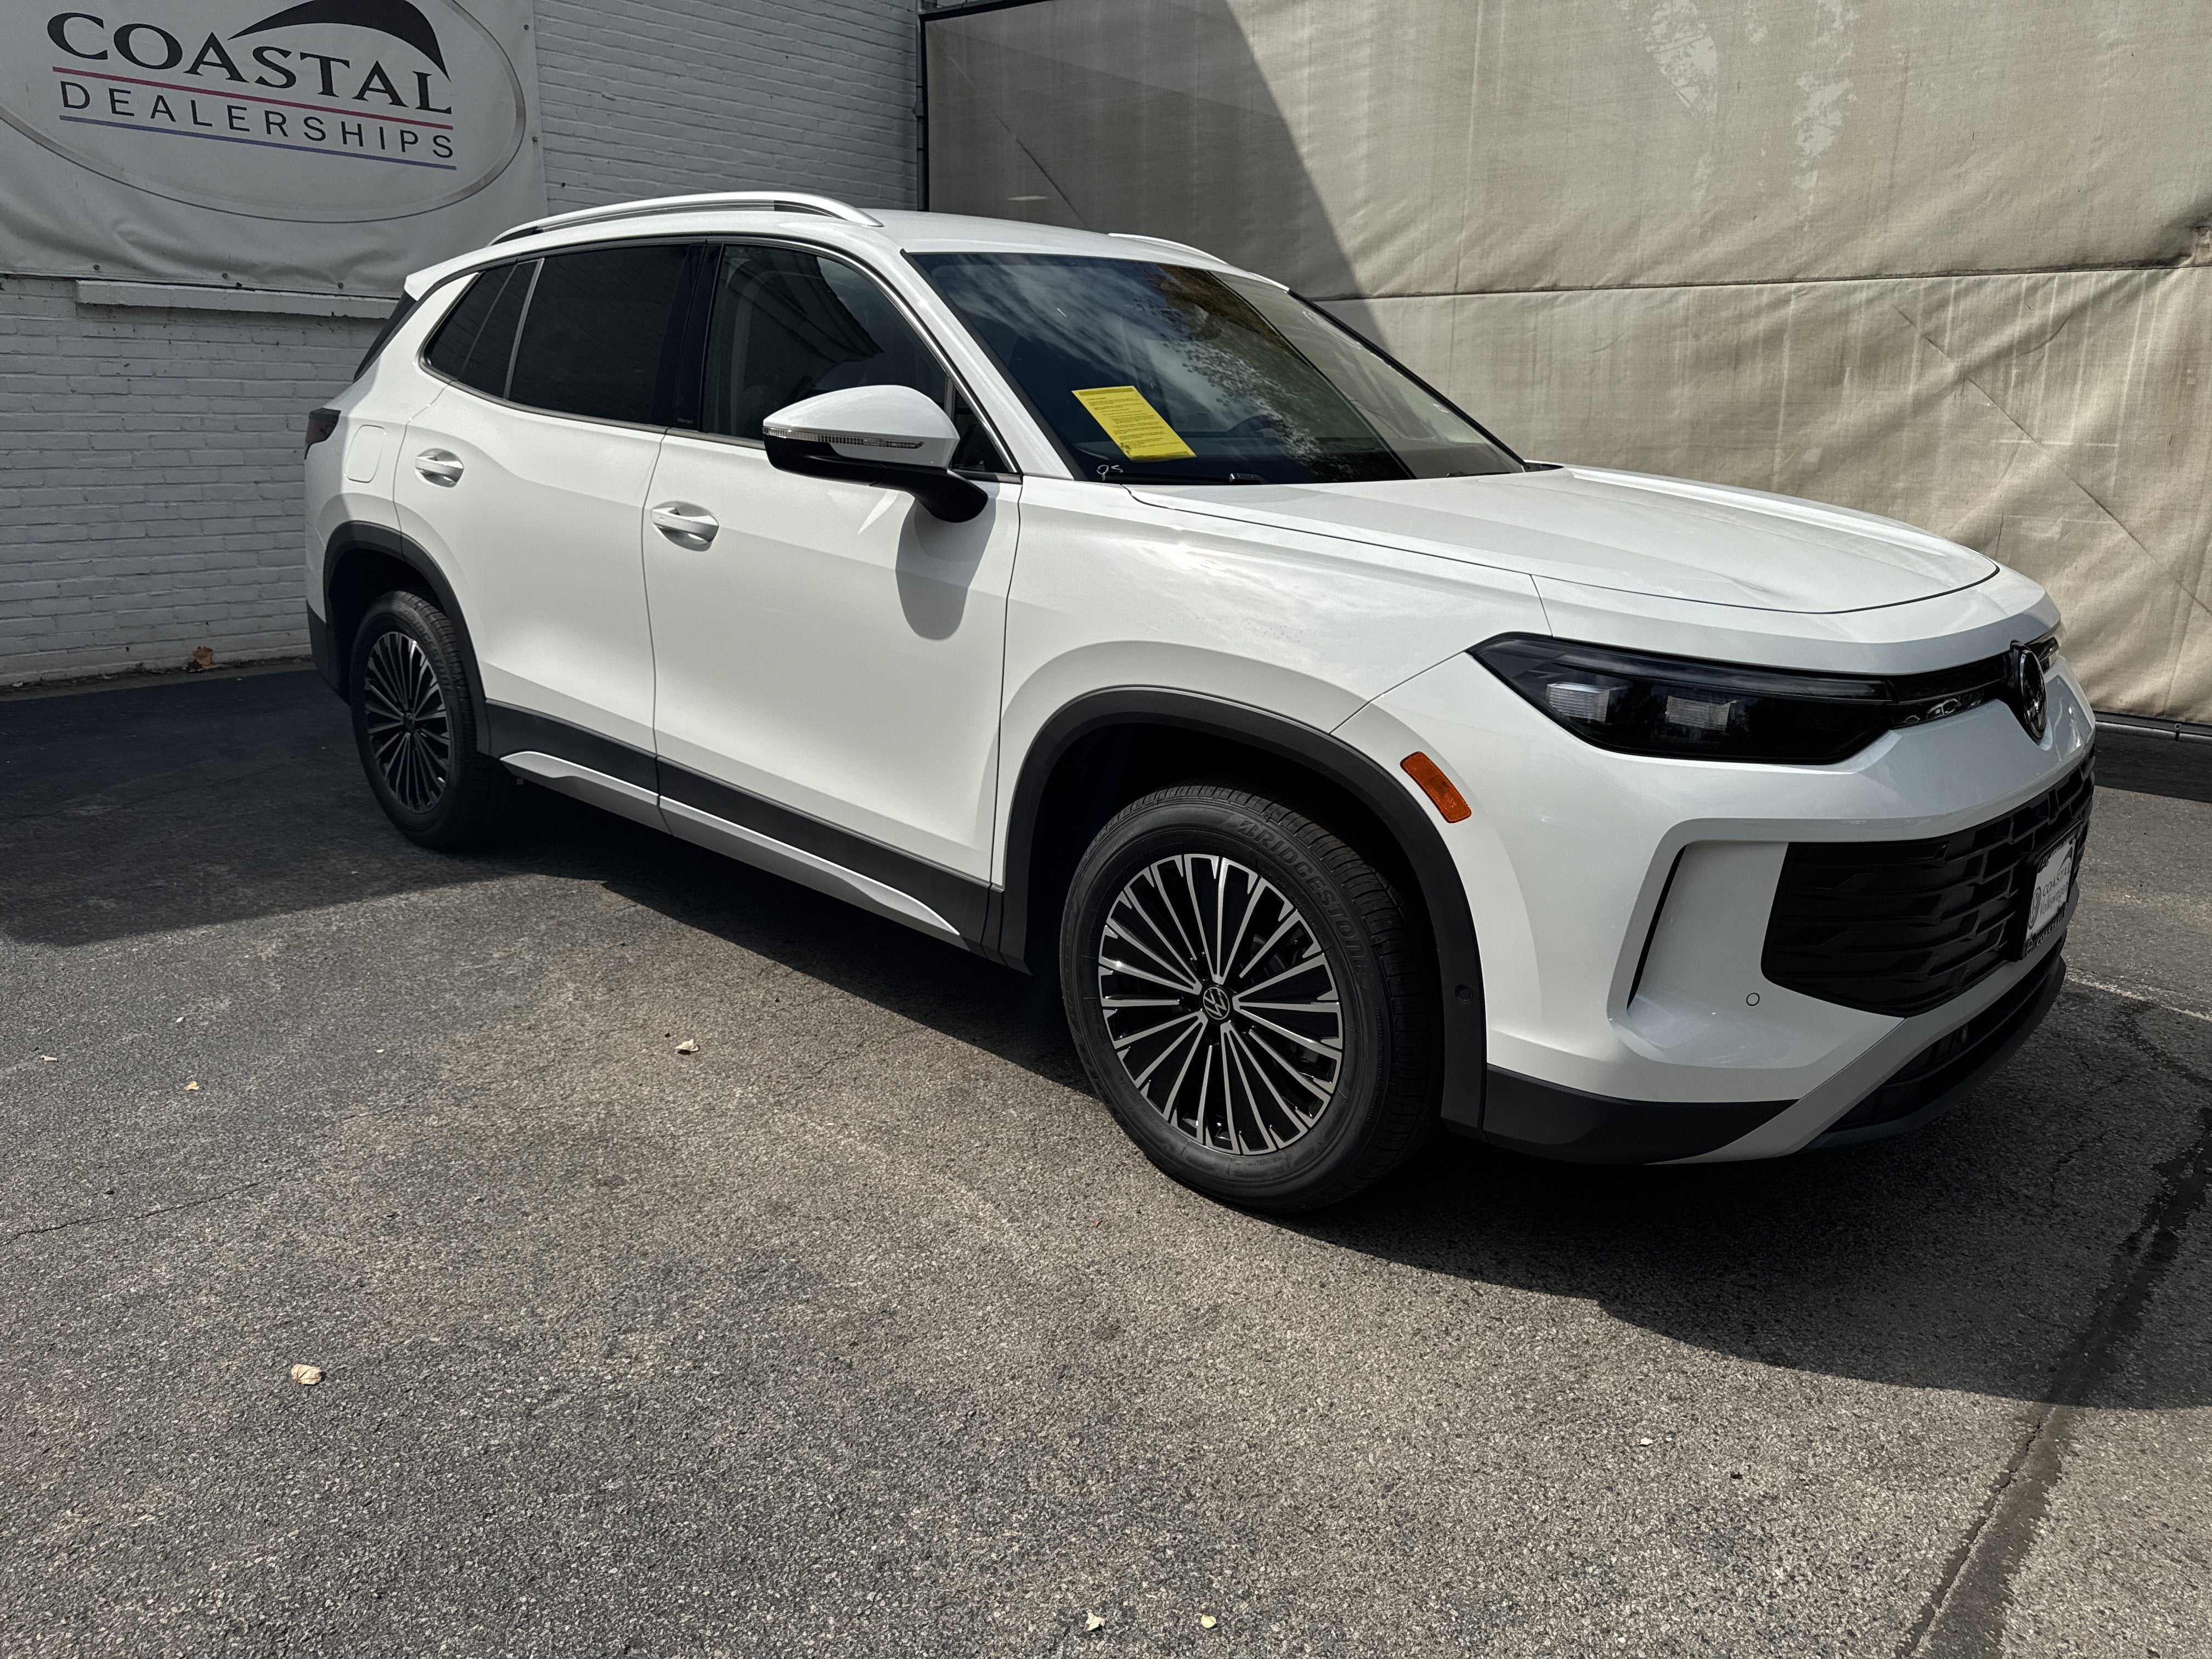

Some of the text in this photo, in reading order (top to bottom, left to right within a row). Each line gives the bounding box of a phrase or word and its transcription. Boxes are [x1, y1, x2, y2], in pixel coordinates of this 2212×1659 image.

[47, 12, 452, 115] COASTAL
[60, 81, 453, 159] DEALERSHIPS
[1236, 820, 1373, 978] BRIDGESTONE
[2043, 862, 2071, 897] COASTAL
[1203, 987, 1230, 1020] VW
